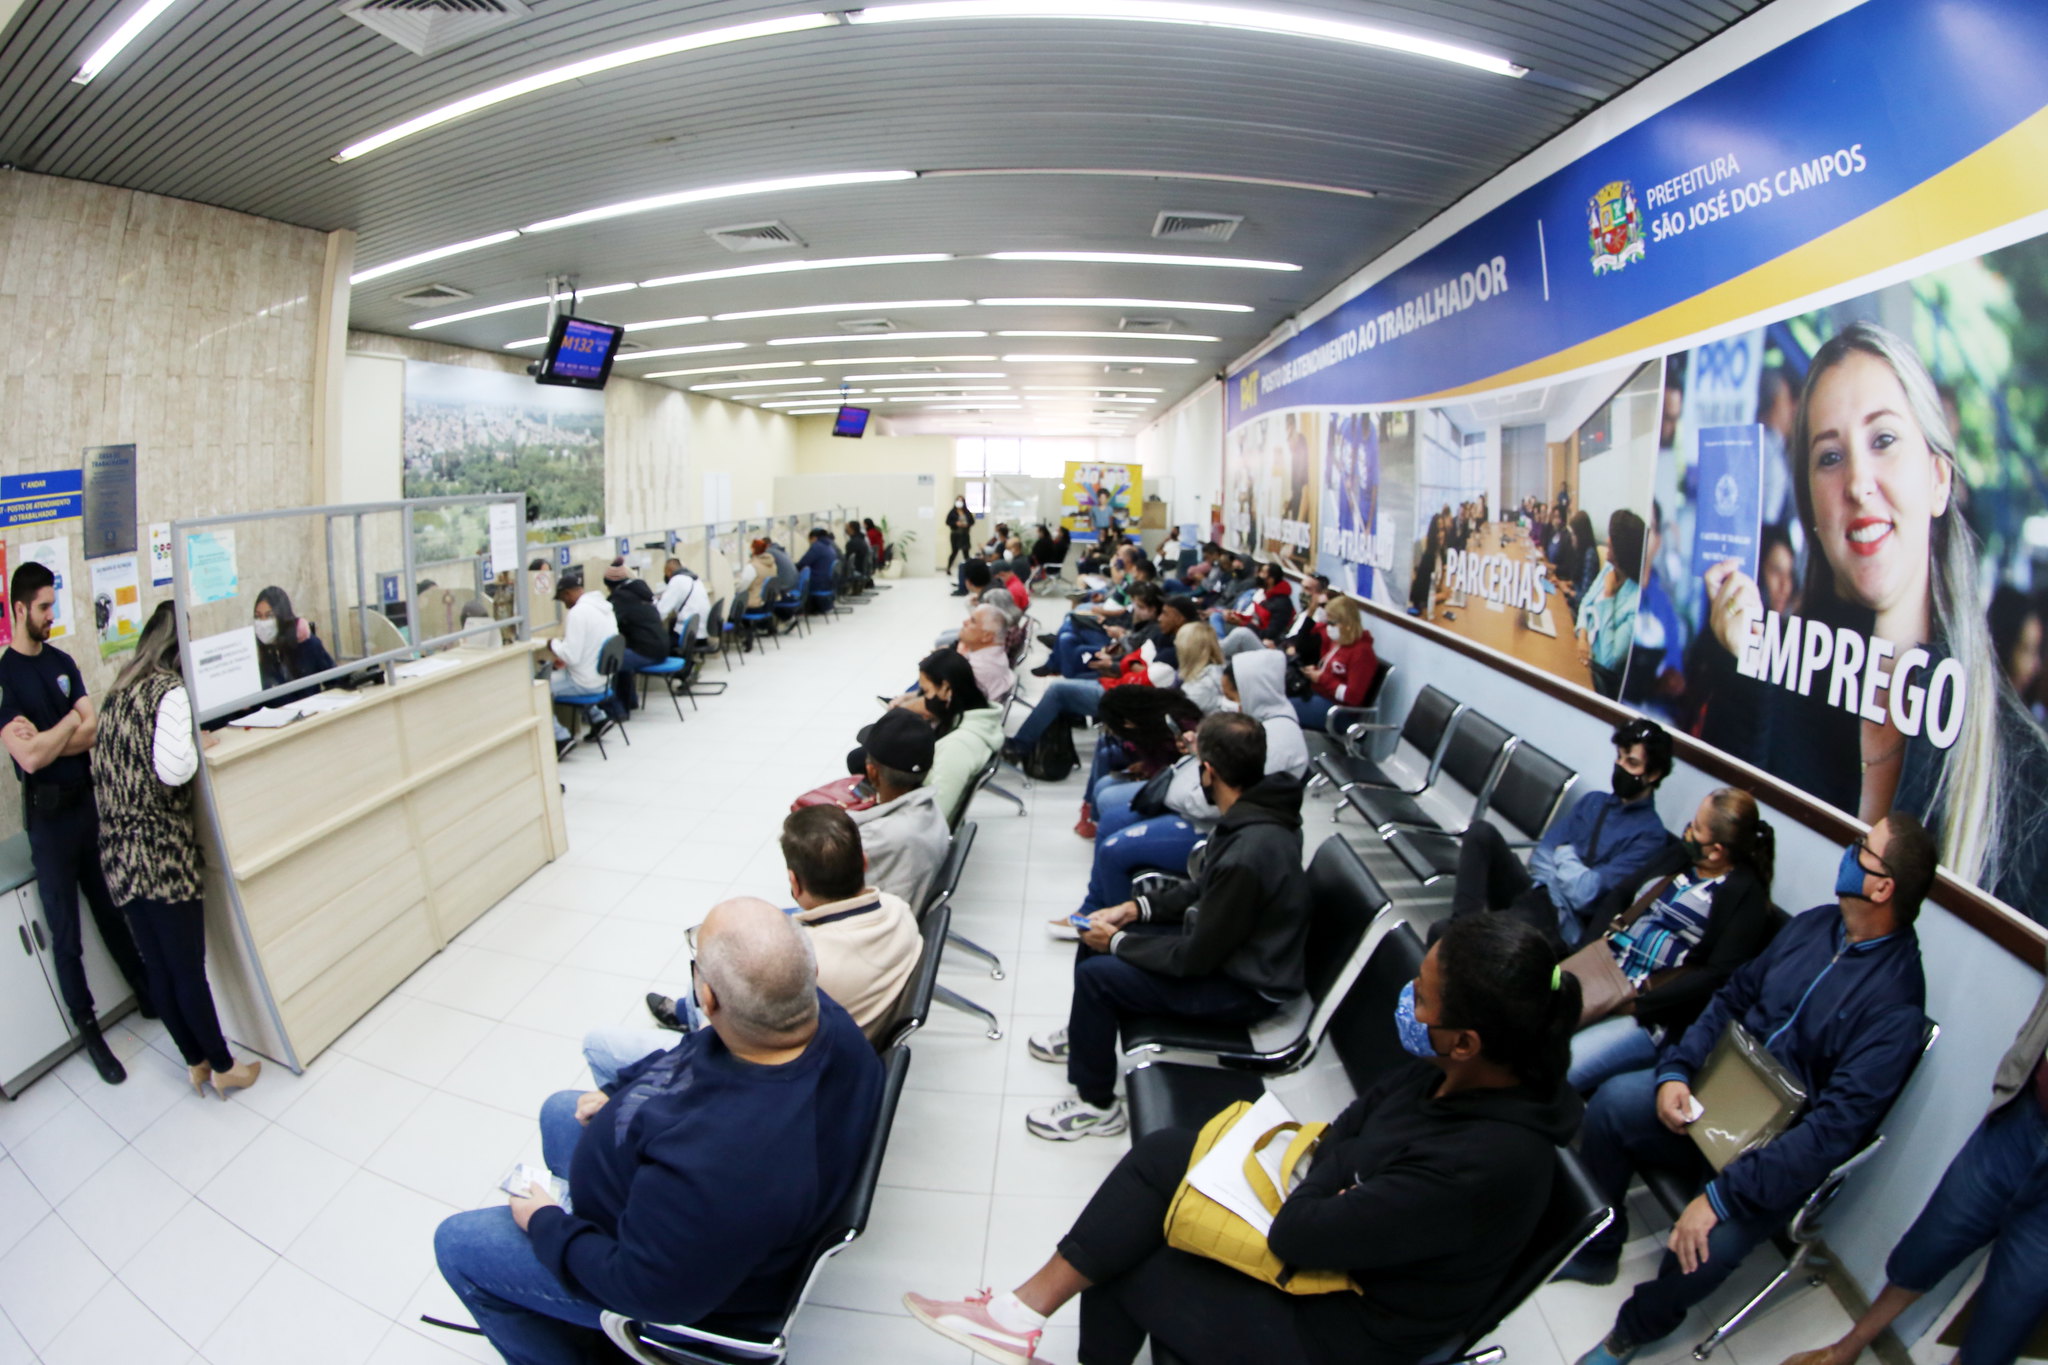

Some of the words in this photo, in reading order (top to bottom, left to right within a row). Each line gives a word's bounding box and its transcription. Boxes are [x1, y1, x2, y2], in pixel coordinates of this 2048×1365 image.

[1646, 153, 1740, 210] PREFEITURA
[1651, 211, 1685, 243] SÃO
[1688, 189, 1730, 230] JOSÉ
[1731, 177, 1773, 214] DOS
[1774, 143, 1867, 197] CAMPOS
[560, 335, 594, 353] M132
[1292, 329, 1357, 382] ATENDIMENTO
[1357, 319, 1377, 354] AO
[1377, 255, 1508, 344] TRABALHADOR
[484, 562, 493, 580] 2
[1446, 547, 1547, 614] PARCERIAS
[1737, 608, 1966, 750] EMPREGO
